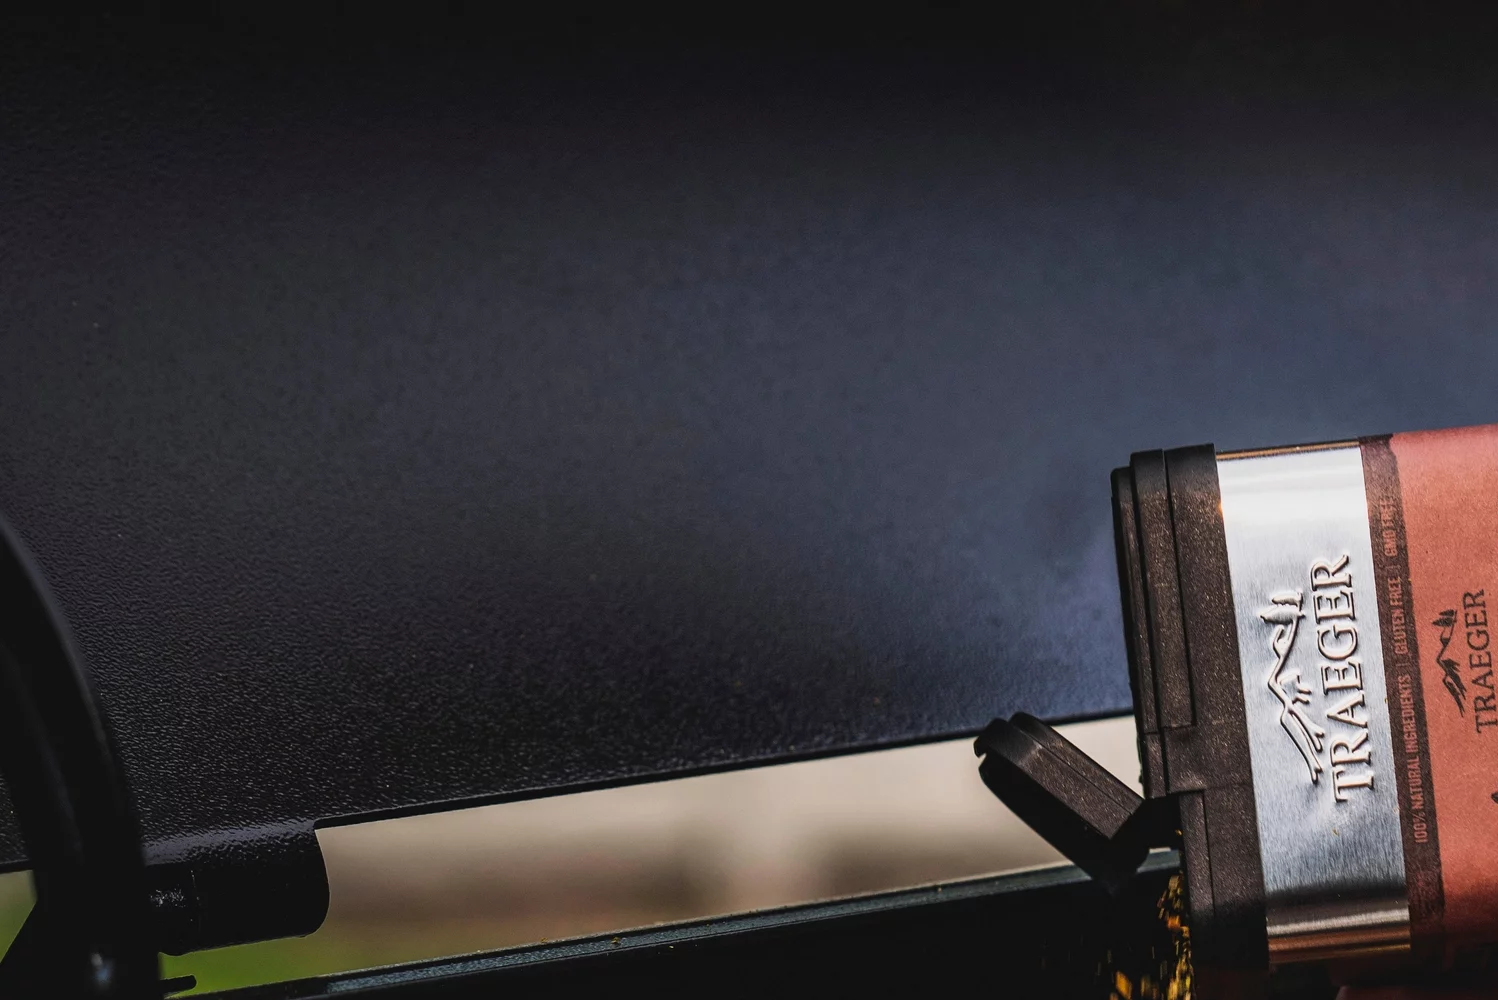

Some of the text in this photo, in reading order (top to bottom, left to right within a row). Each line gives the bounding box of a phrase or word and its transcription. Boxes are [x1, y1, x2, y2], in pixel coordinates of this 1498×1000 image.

[1310, 553, 1375, 803] TRAEGER
[1379, 498, 1429, 843] 100% NATURAL INGREDIENTS GLUTEN FREE GMO FREE
